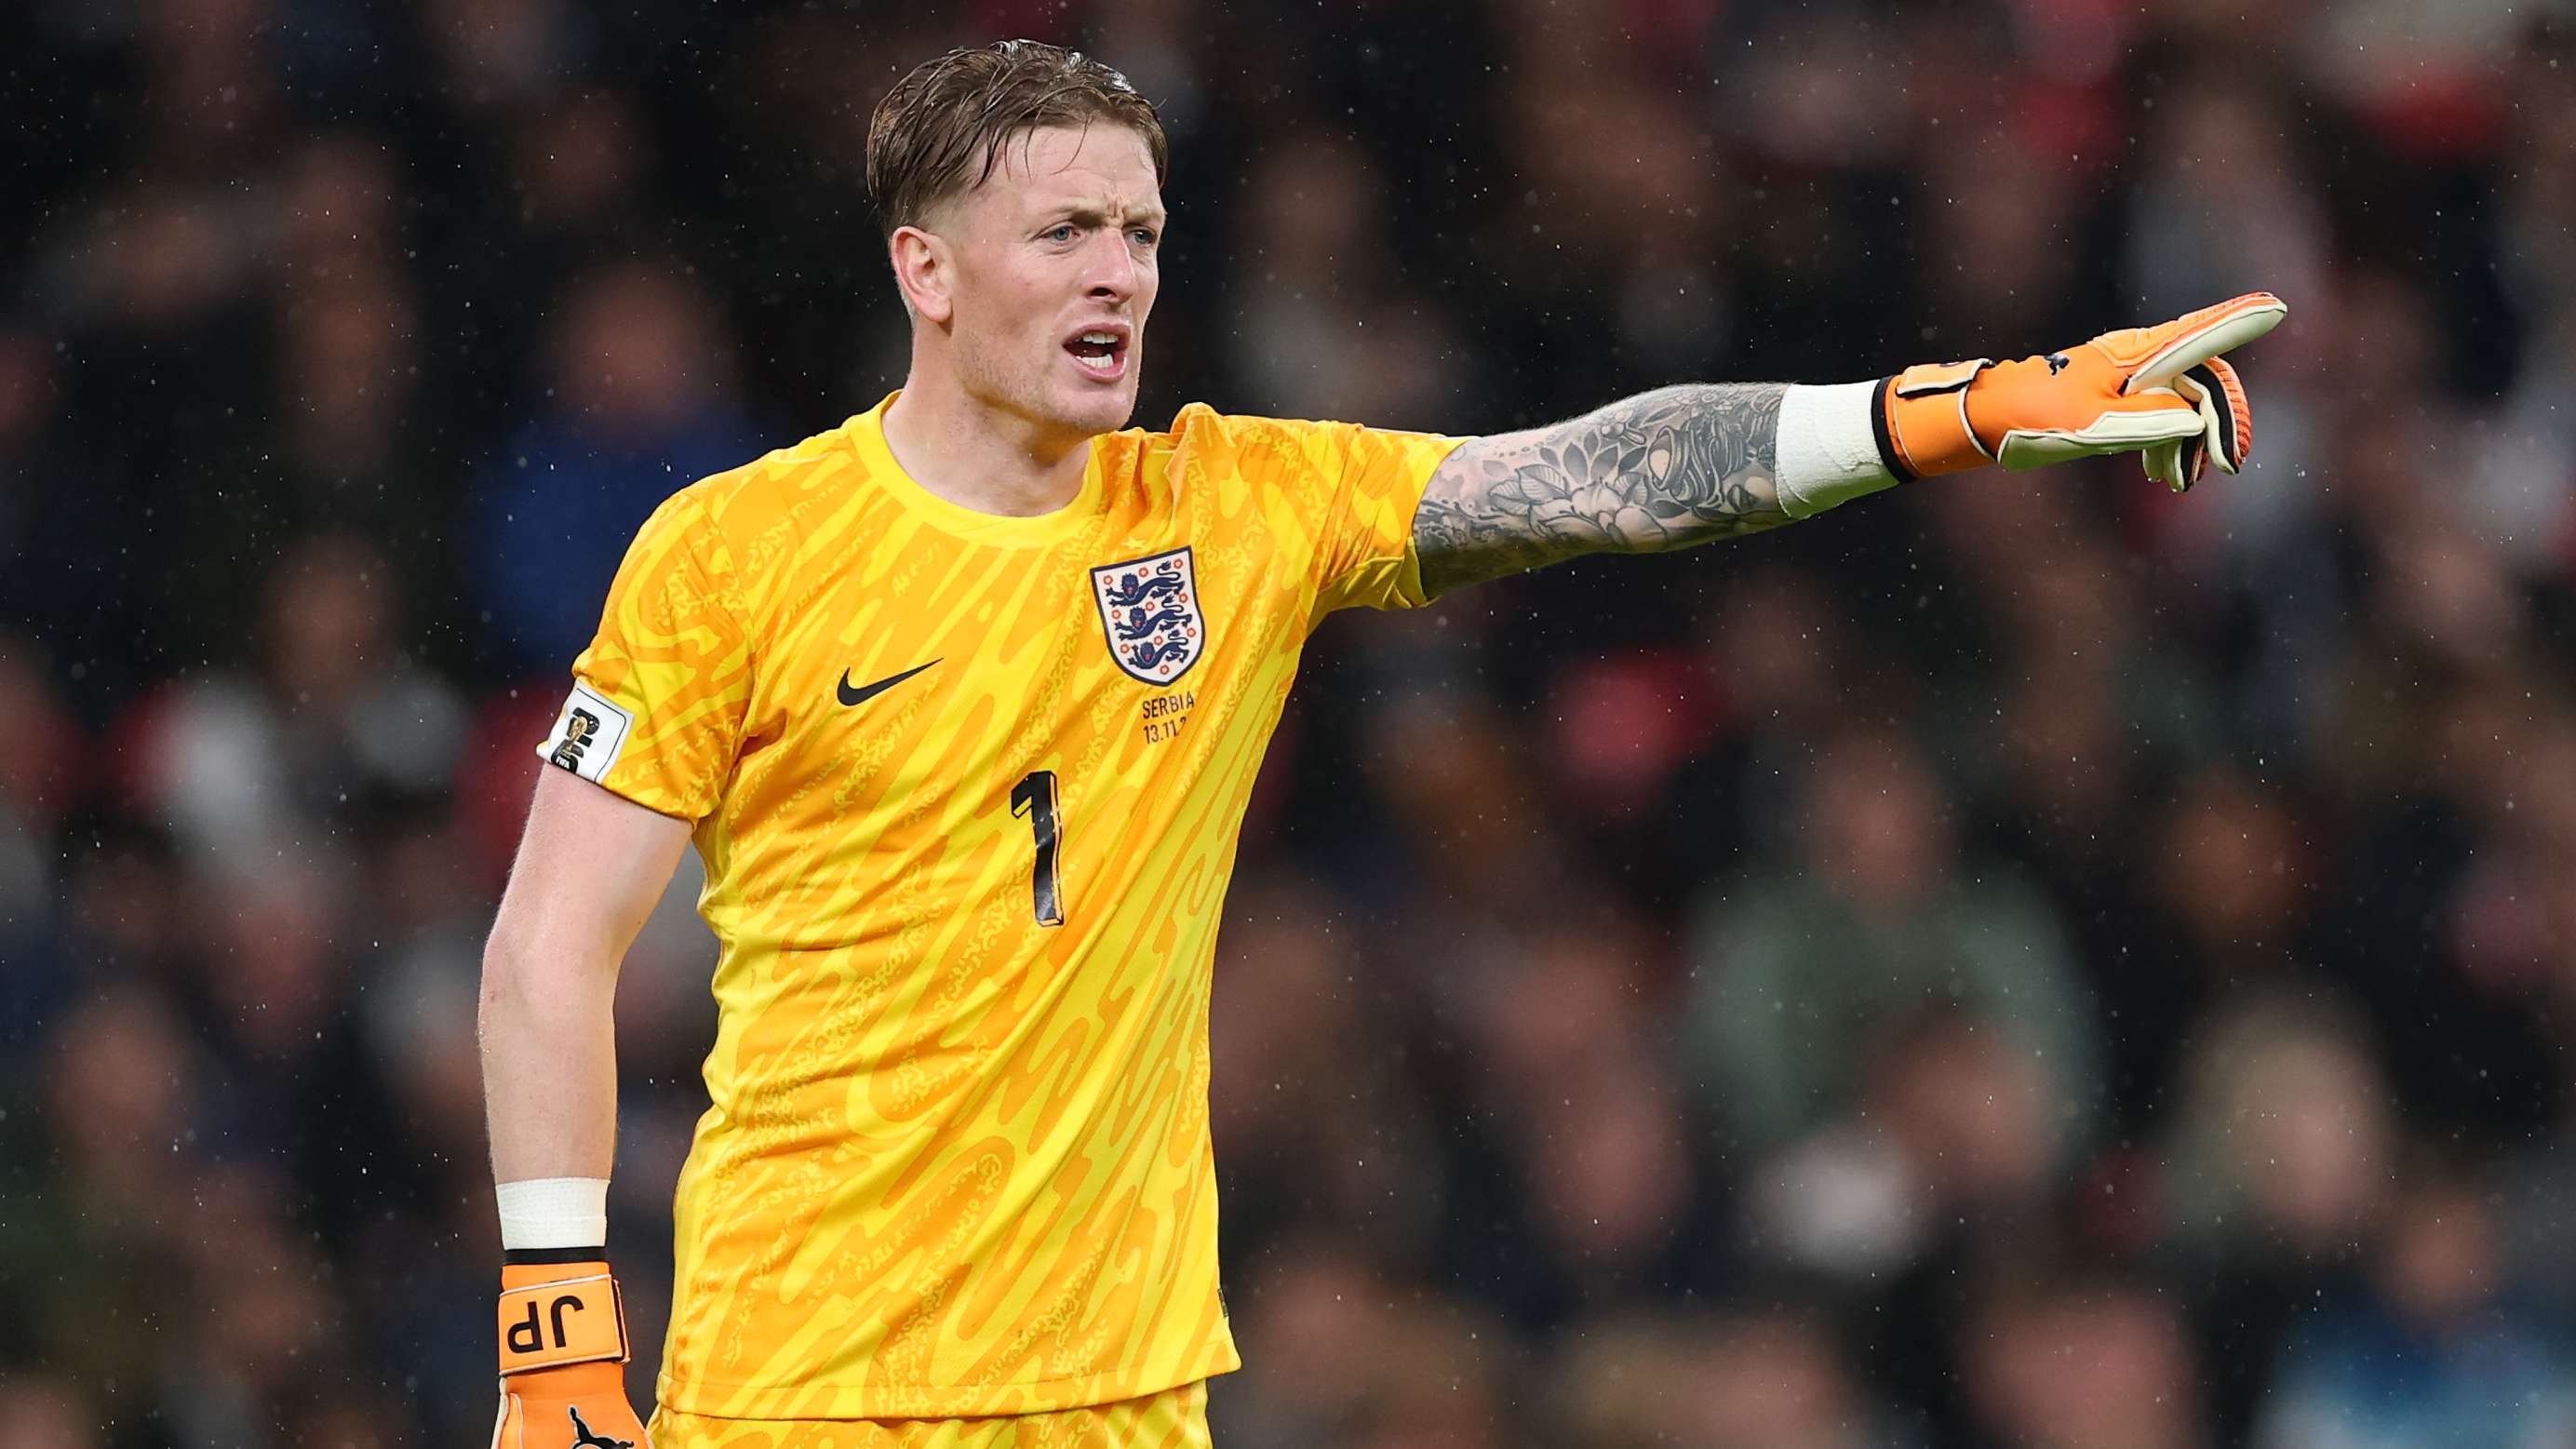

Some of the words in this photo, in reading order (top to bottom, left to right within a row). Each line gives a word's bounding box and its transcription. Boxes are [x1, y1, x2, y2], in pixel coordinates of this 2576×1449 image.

[1143, 691, 1194, 719] SERBIA
[1011, 771, 1064, 927] 1
[507, 1295, 584, 1354] JP
